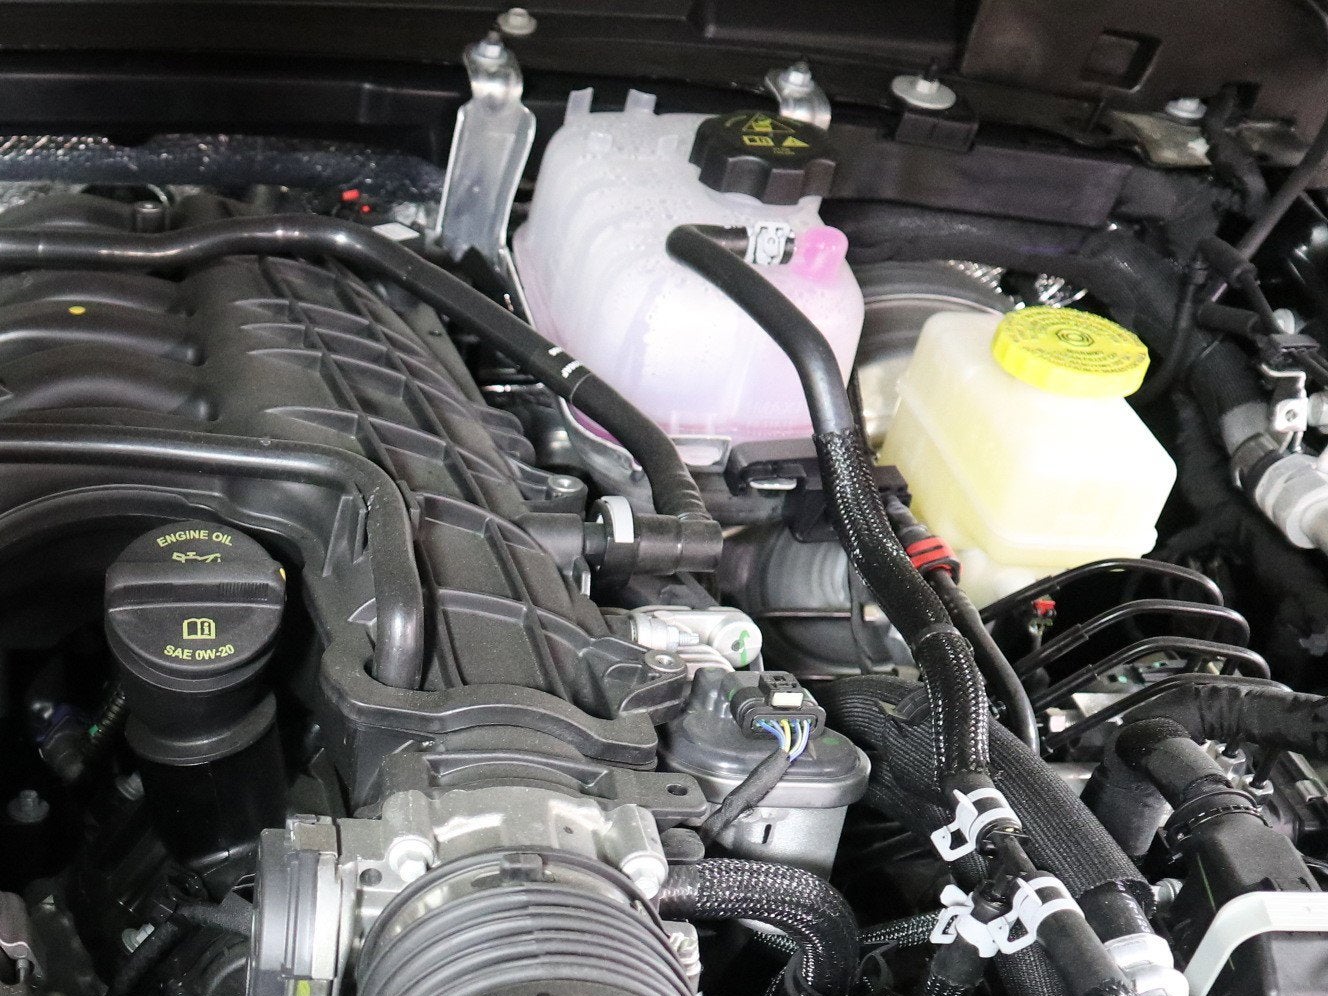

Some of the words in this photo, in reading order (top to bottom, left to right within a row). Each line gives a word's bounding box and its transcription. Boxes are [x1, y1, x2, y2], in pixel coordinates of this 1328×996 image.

[156, 530, 209, 547] ENGINE
[212, 531, 234, 547] OIL
[163, 644, 192, 660] SAE
[195, 643, 235, 661] 0W-20
